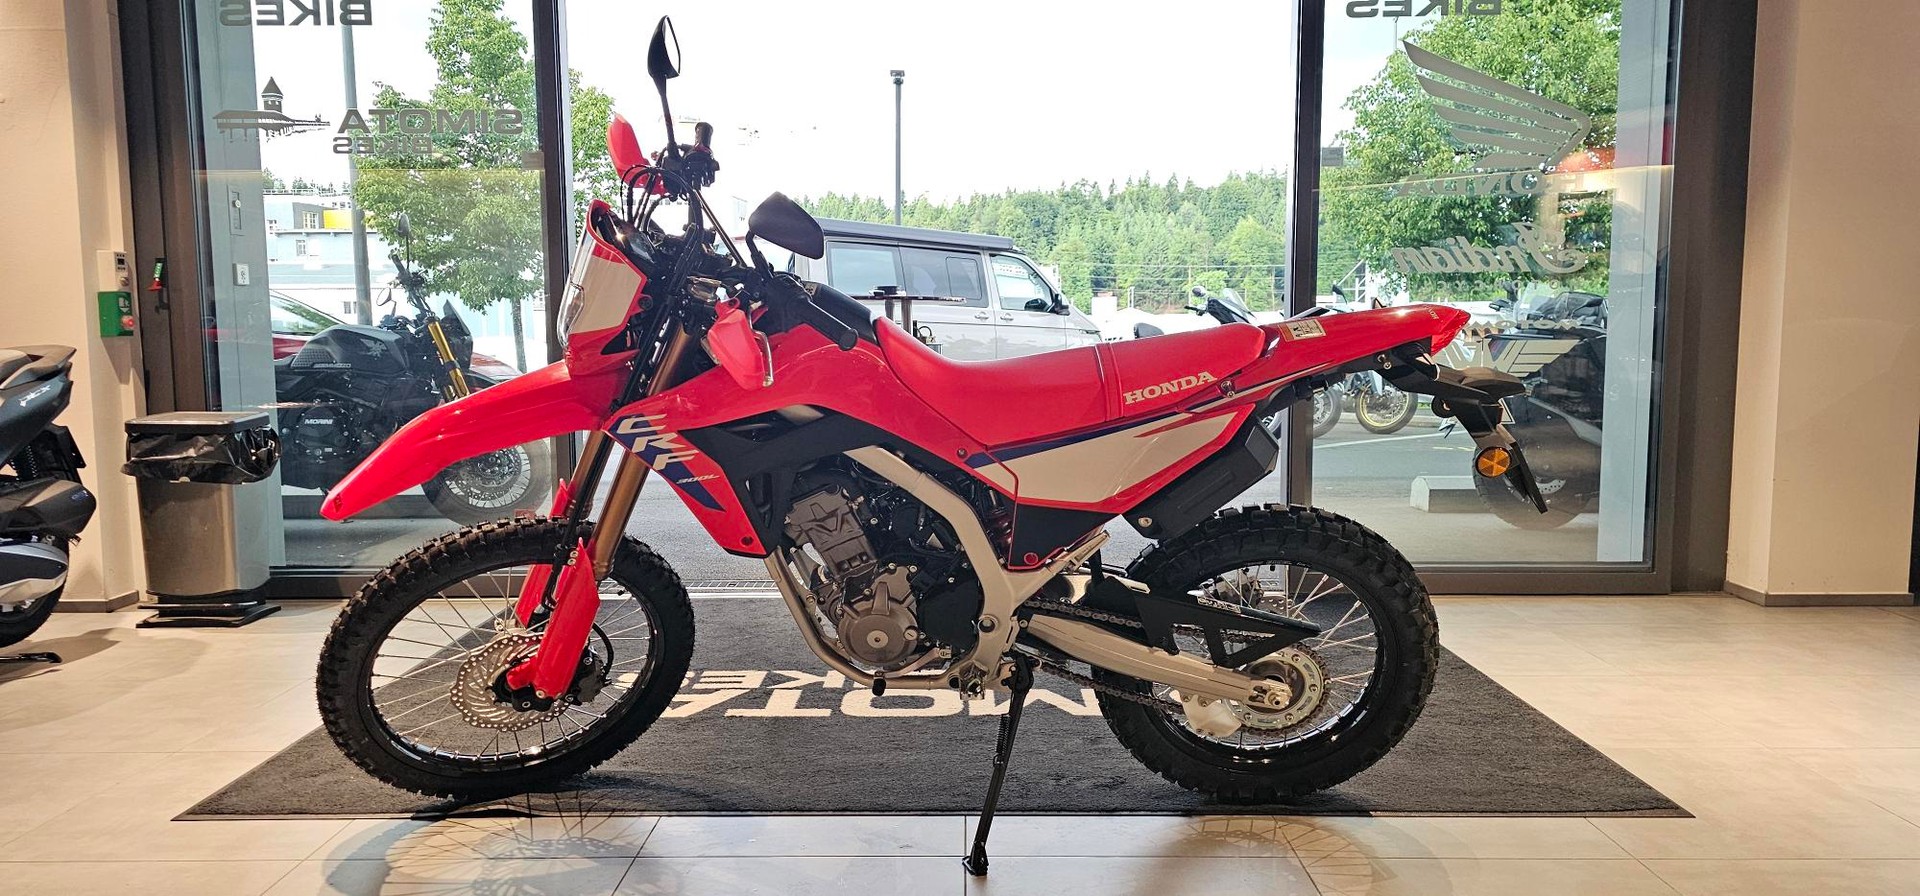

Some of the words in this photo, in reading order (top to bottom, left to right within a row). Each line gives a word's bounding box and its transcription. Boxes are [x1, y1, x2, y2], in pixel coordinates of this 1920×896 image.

[1122, 371, 1218, 405] HONDA
[304, 418, 334, 426] MORINI
[616, 413, 700, 472] CRF
[675, 473, 721, 485] 300L
[659, 687, 1104, 718] MOTA
